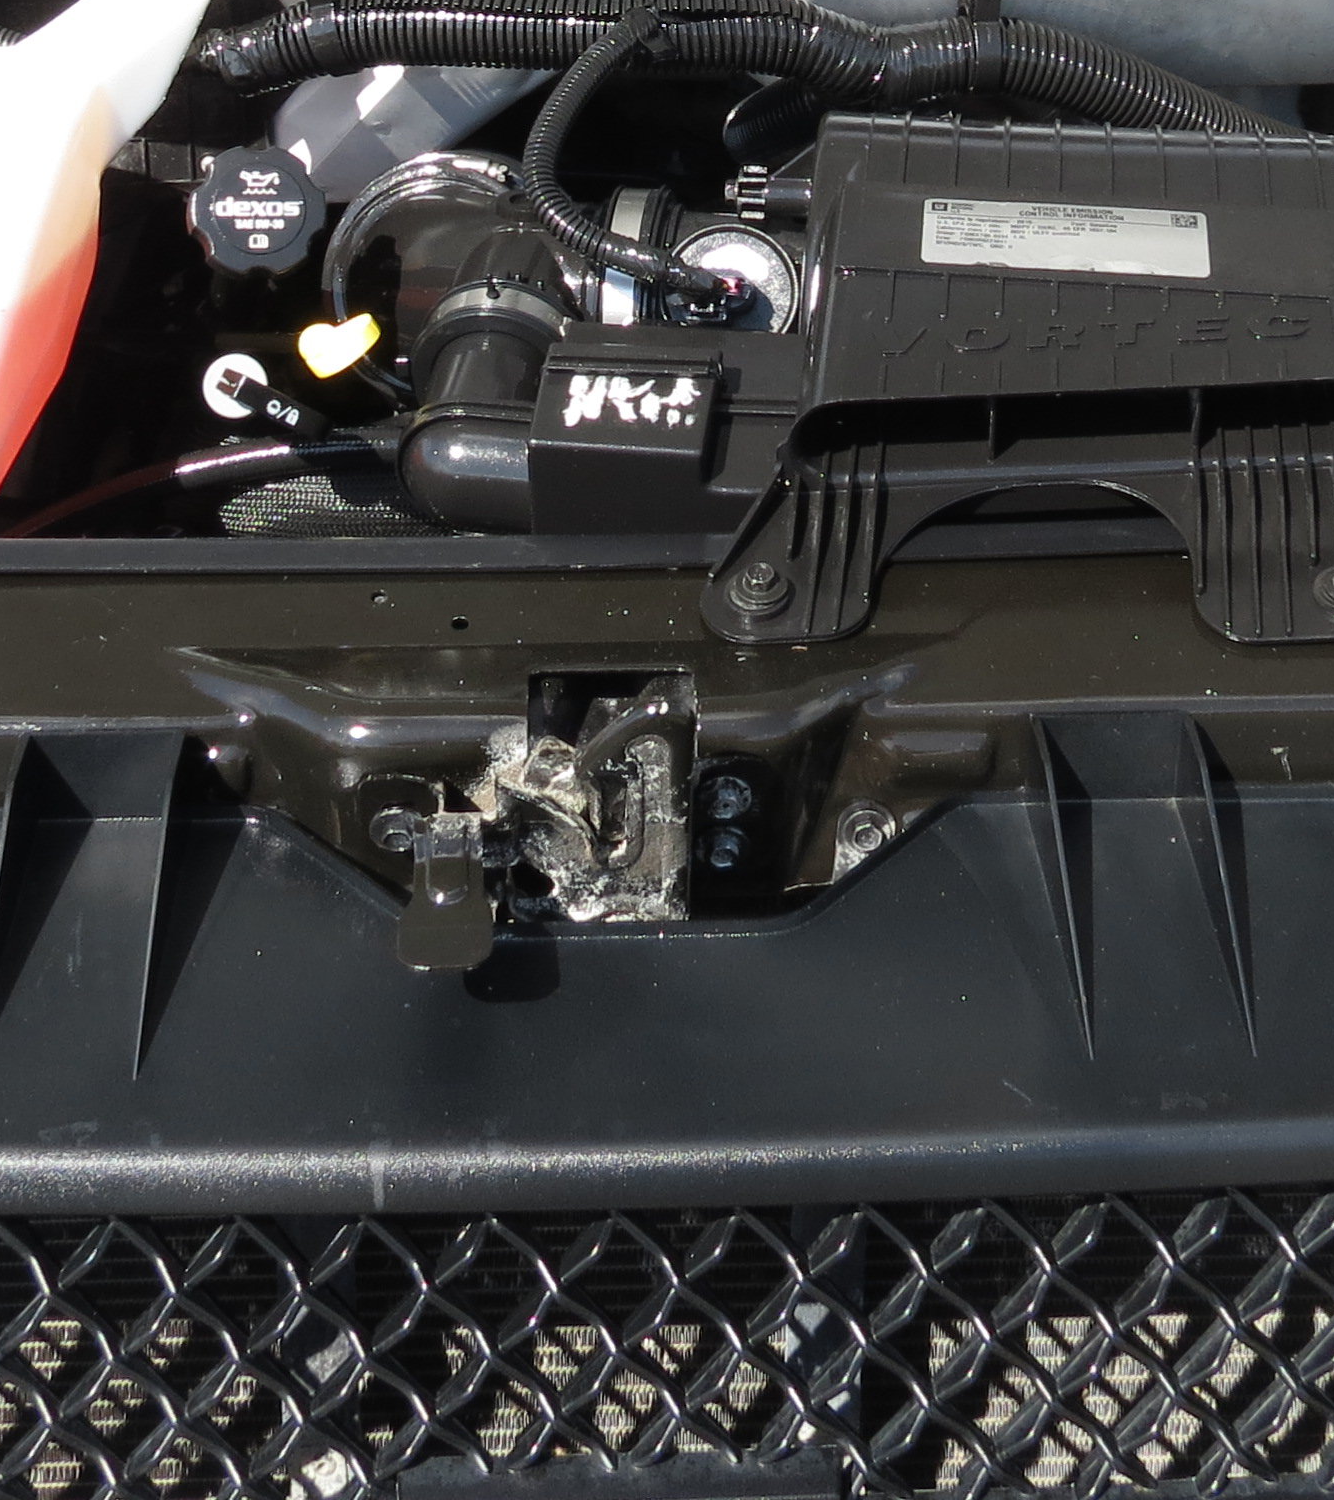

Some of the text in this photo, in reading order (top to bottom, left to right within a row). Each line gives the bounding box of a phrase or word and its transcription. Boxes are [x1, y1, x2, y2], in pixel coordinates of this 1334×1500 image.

[215, 196, 300, 217] dexos
[1071, 207, 1113, 215] EMISSION
[1063, 212, 1124, 220] INFORMATION
[872, 313, 1312, 357] VORTEC
